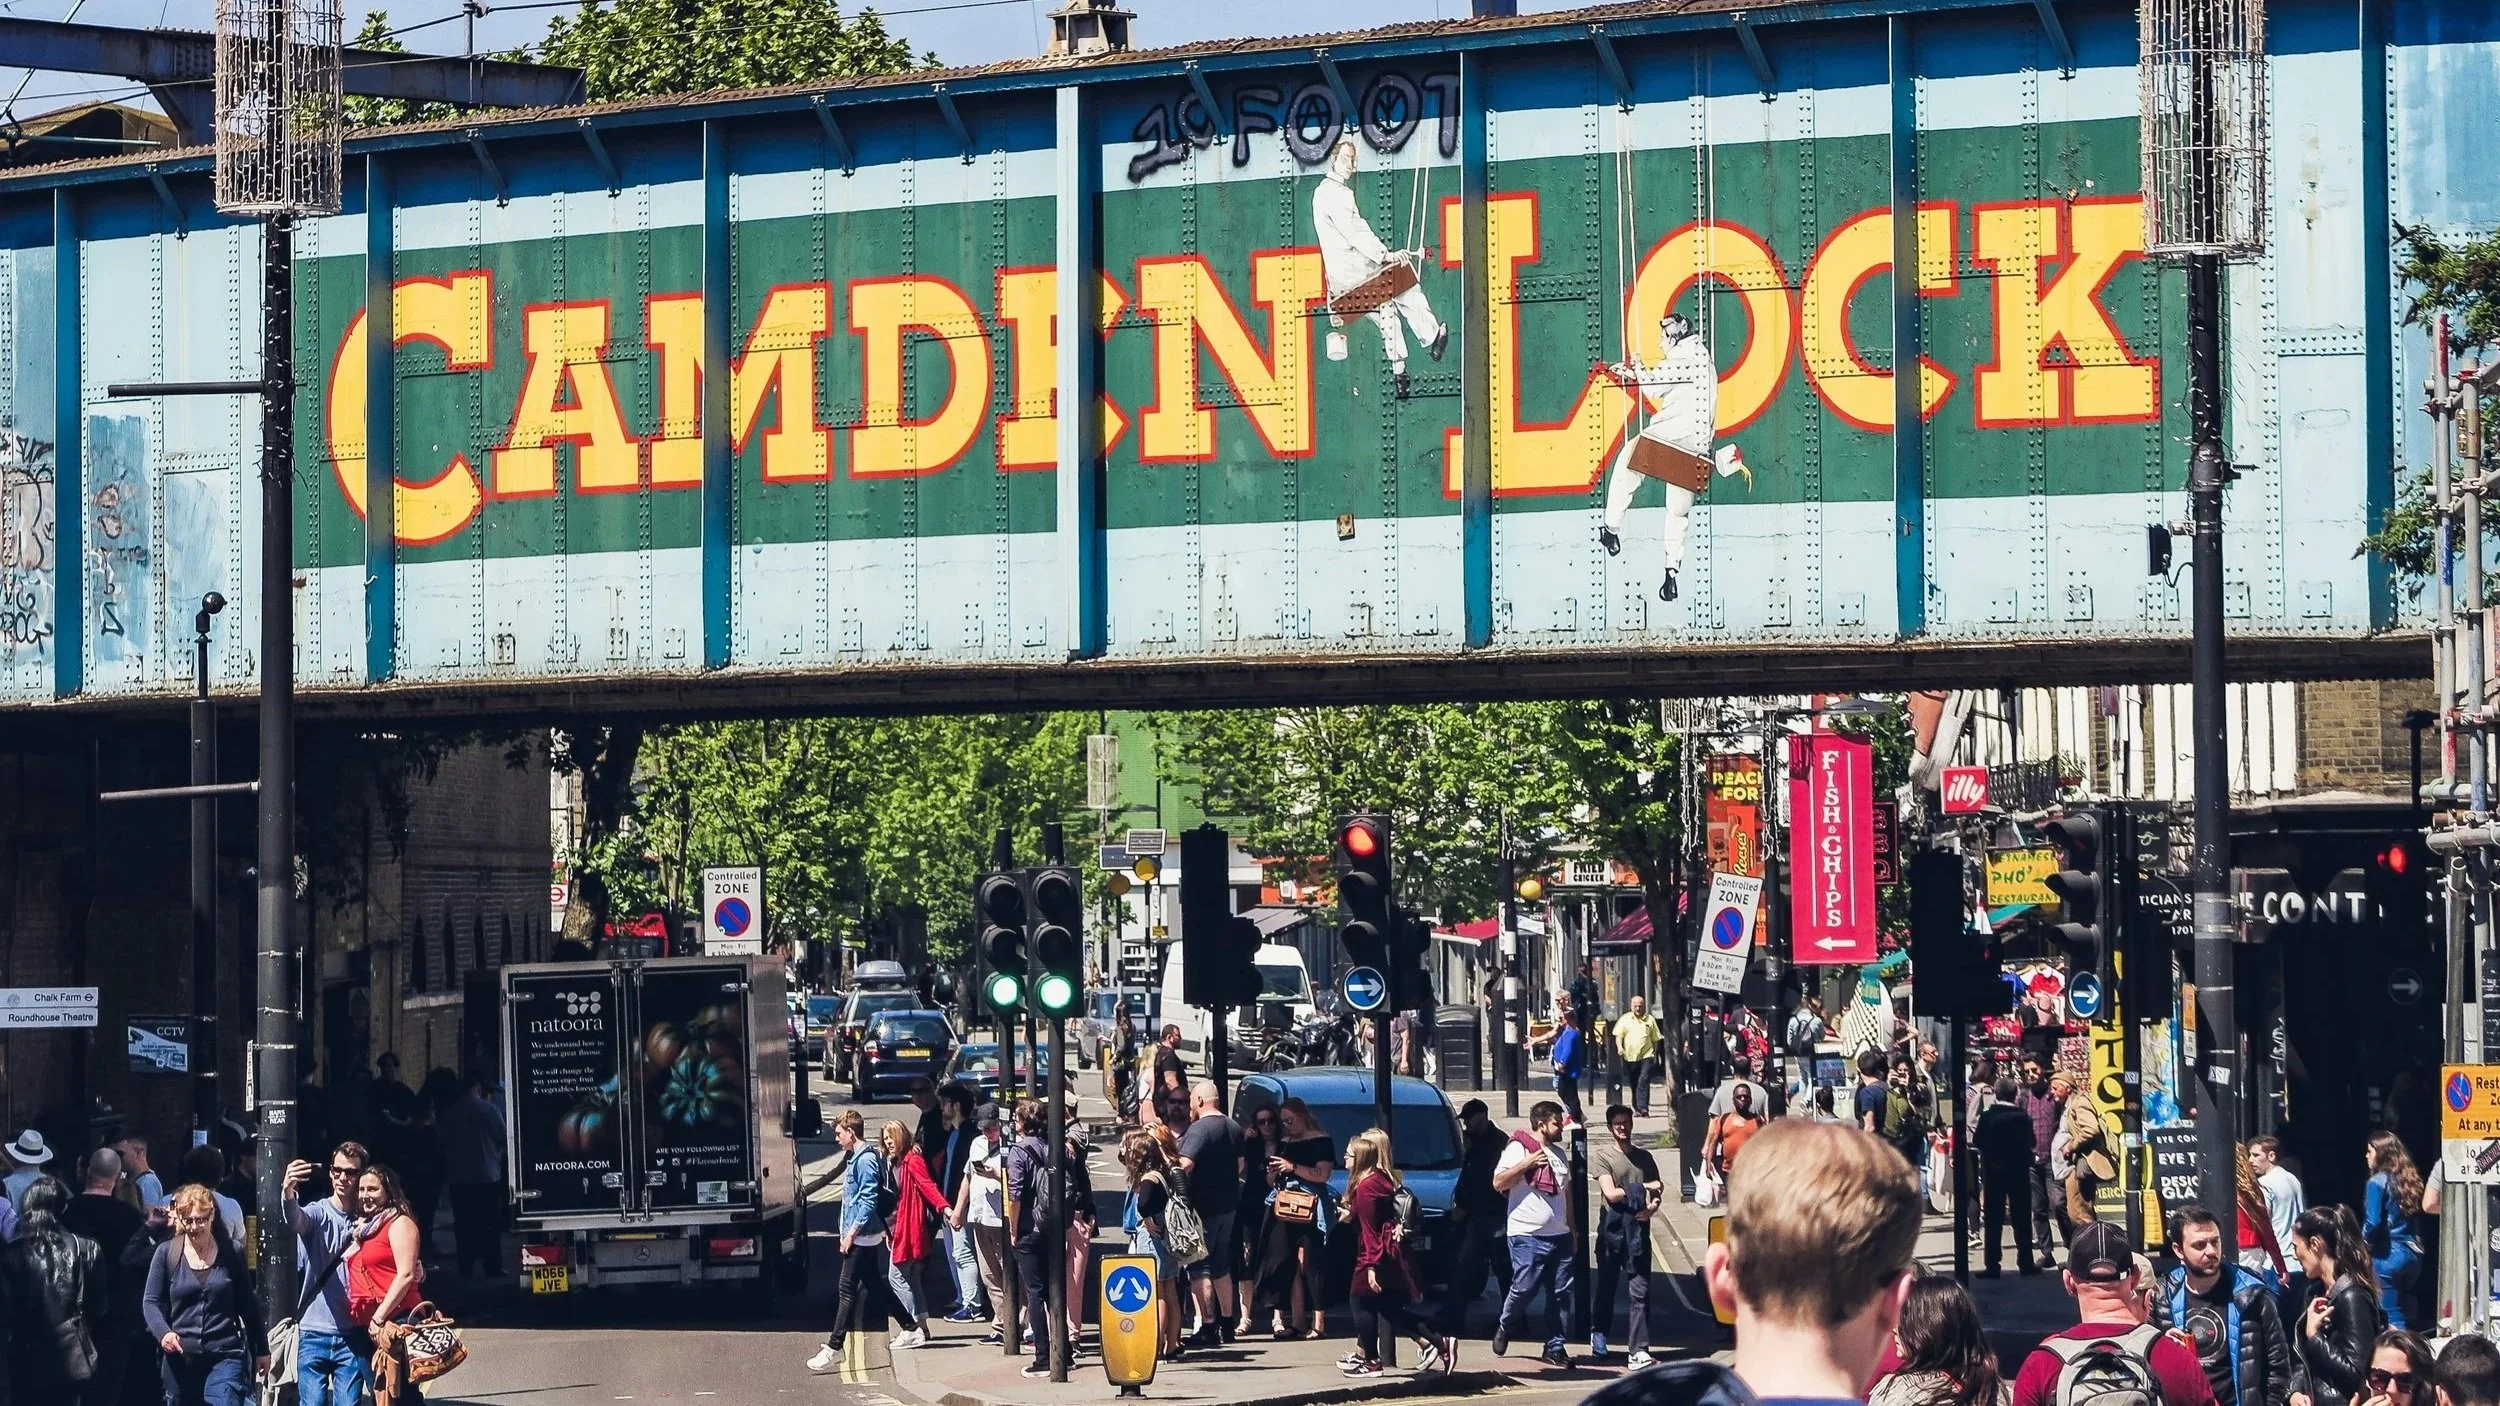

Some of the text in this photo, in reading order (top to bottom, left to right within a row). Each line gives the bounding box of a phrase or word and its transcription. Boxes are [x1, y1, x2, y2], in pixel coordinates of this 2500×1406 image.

[327, 190, 2160, 548] CAMDEN LOCK
[1821, 750, 1841, 824] FISH
[1947, 774, 1985, 808] illy
[1722, 786, 1759, 801] FOR
[1573, 861, 1605, 874] FRIED
[707, 871, 757, 881] Controlled
[1573, 874, 1605, 882] CHICKEN
[1715, 877, 1759, 891] Controlled
[1821, 836, 1842, 928] CHIPS
[715, 883, 750, 894] ZONE
[1719, 890, 1750, 905] ZONE
[2139, 893, 2193, 906] TICIANS
[34, 993, 82, 1002] Chalk Farm
[8, 1012, 94, 1023] Roundhouse Theatre
[156, 1026, 185, 1036] CCTV
[530, 1018, 603, 1033] natoora
[531, 1041, 542, 1049] We
[544, 1040, 581, 1049] understand
[560, 1050, 577, 1058] great
[532, 1068, 544, 1076] We
[559, 1067, 582, 1076] change
[546, 1078, 559, 1086] you
[560, 1077, 577, 1086] enjoy
[541, 1086, 574, 1095] vegetables
[2458, 1118, 2473, 1131] At
[2473, 1120, 2492, 1133] any
[2156, 1134, 2198, 1144] EYE CON
[686, 1145, 725, 1153] FOLLOWING
[726, 1144, 740, 1152] US?
[2158, 1152, 2185, 1165] EYE
[535, 1160, 610, 1171] NATOORA.COM
[2161, 1186, 2198, 1200] GLA
[539, 1279, 562, 1291] JVE
